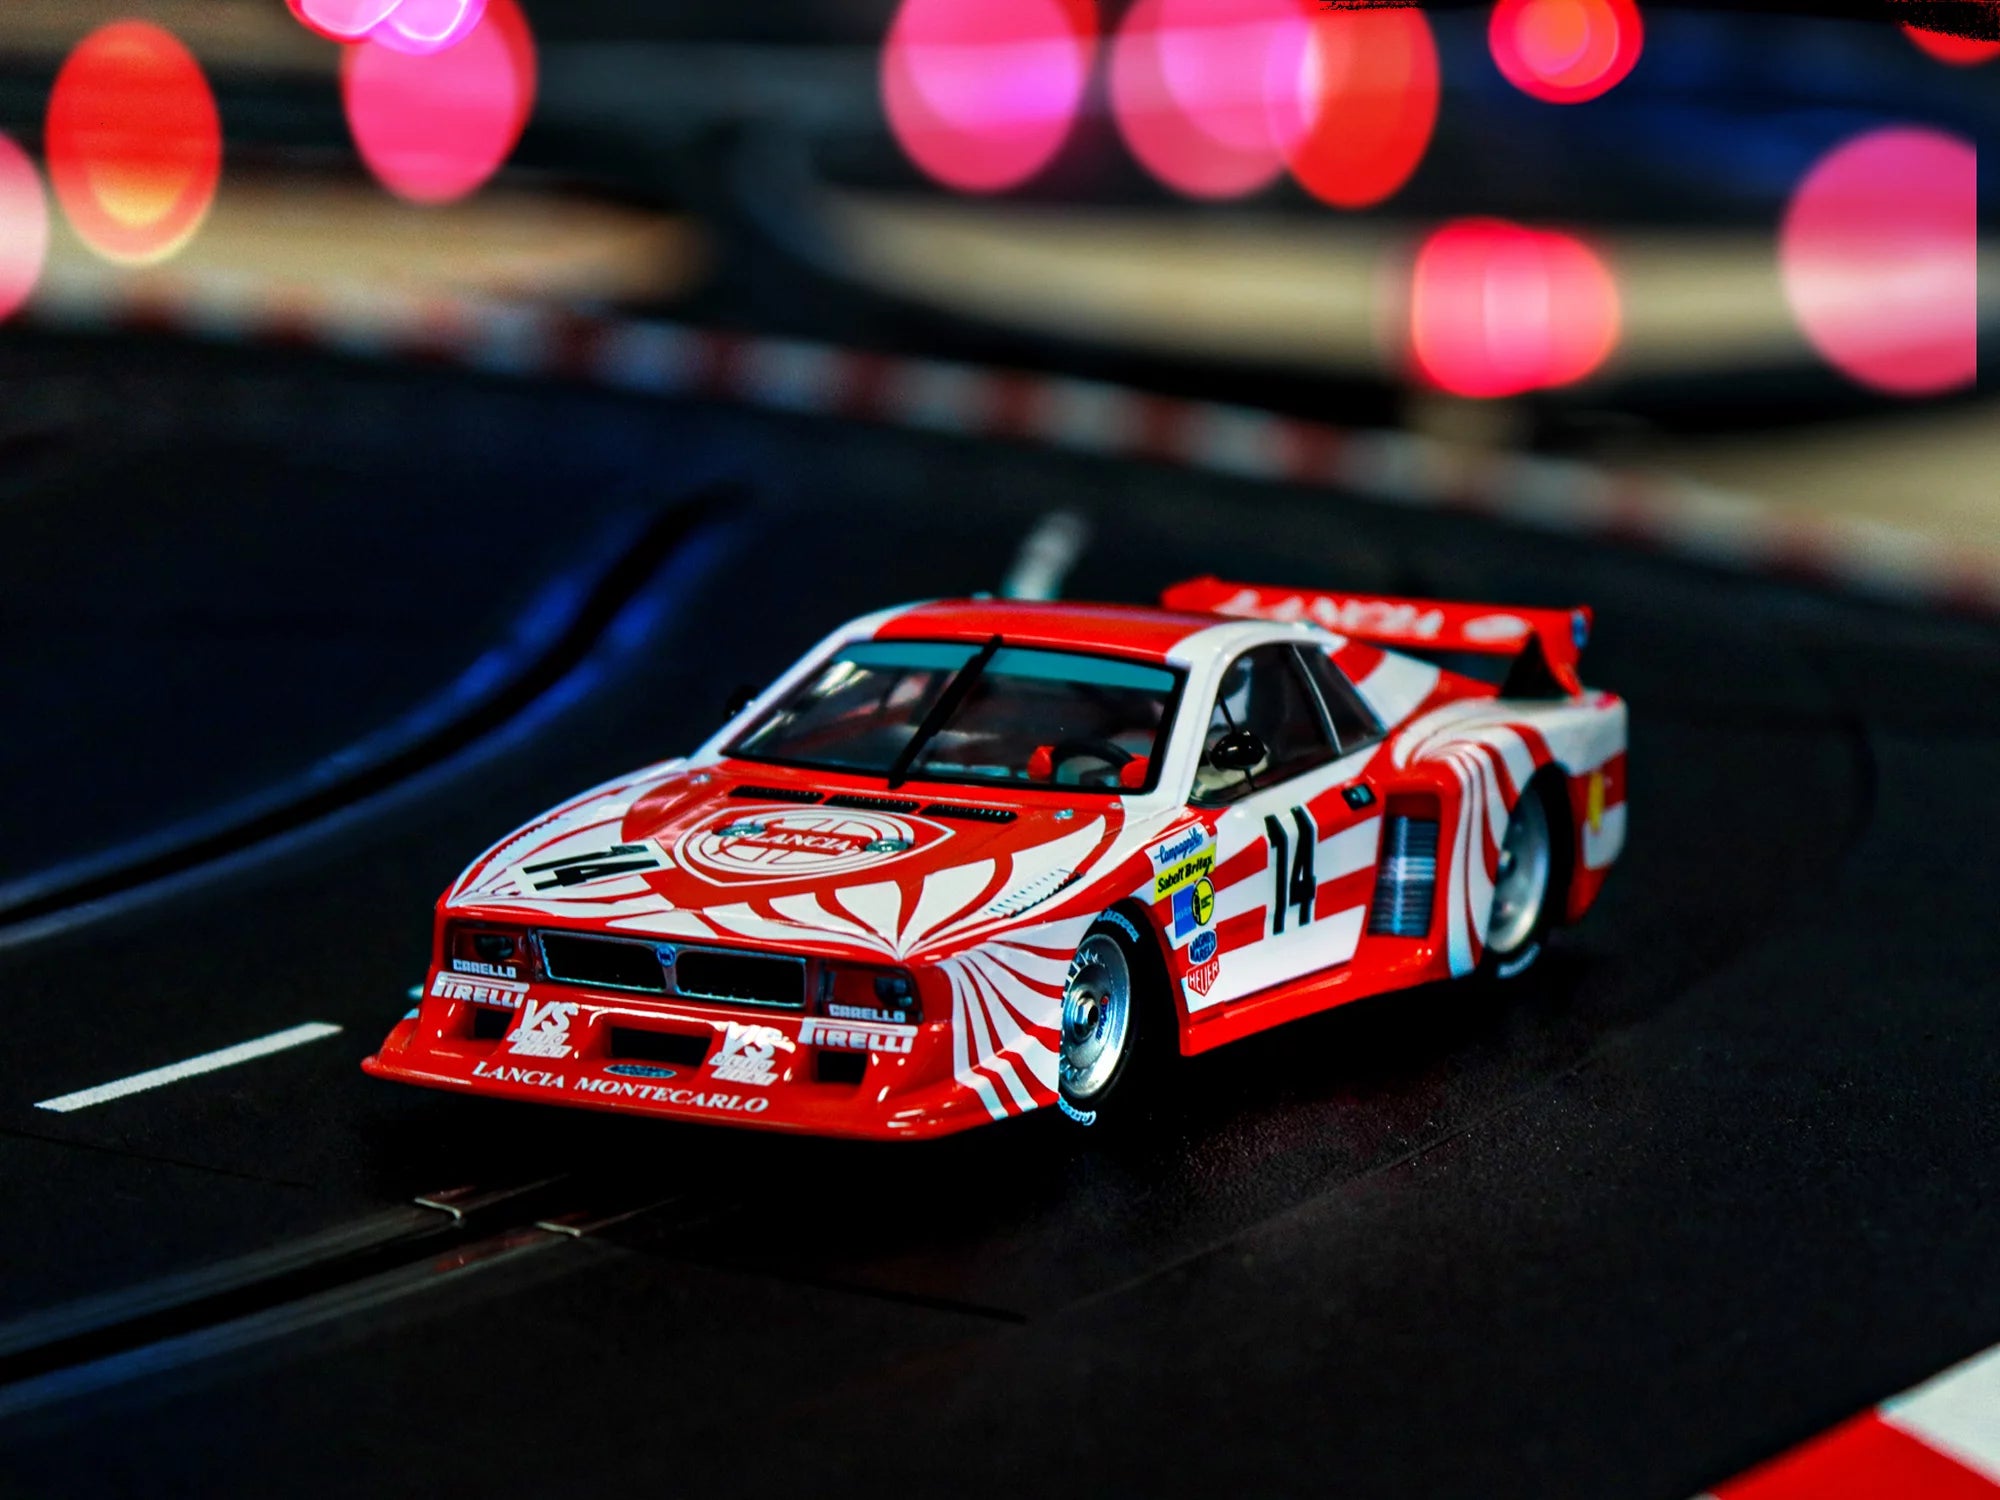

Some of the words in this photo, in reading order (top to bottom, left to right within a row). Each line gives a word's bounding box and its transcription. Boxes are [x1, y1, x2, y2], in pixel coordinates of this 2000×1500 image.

[744, 831, 852, 852] LANCIA
[1264, 805, 1317, 935] 14
[452, 959, 517, 979] CARELLO
[1189, 961, 1219, 995] HEUER
[430, 970, 530, 1009] PIRELLI
[520, 998, 579, 1034] VS
[828, 1003, 906, 1023] CARELLO
[797, 1016, 918, 1054] PIRELLI
[472, 1061, 566, 1089] LANCIA
[573, 1076, 769, 1113] MONTECARLO
